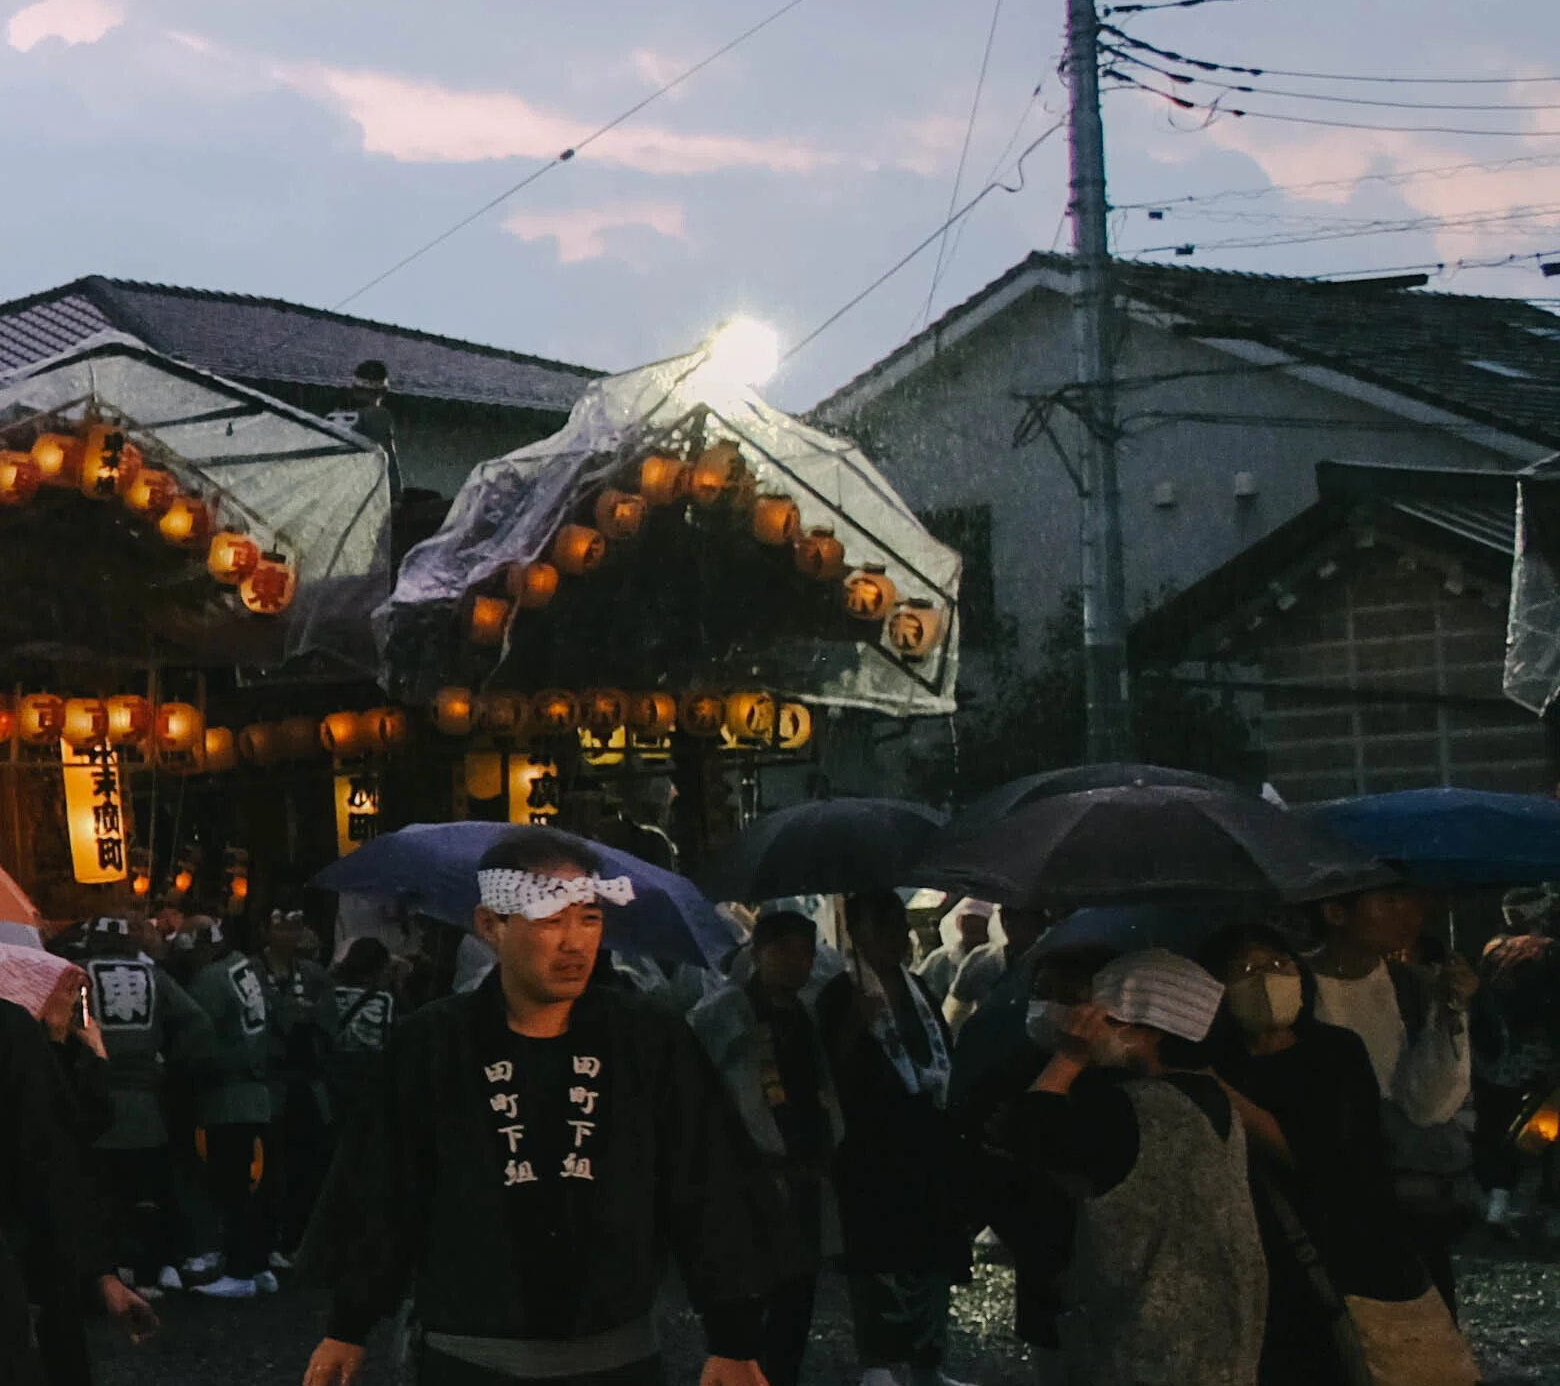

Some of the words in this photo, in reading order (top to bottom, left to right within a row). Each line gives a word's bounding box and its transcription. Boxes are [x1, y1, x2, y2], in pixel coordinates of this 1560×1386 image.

[484, 1059, 539, 1187] 田町下組
[558, 1054, 602, 1182] 田町下組
